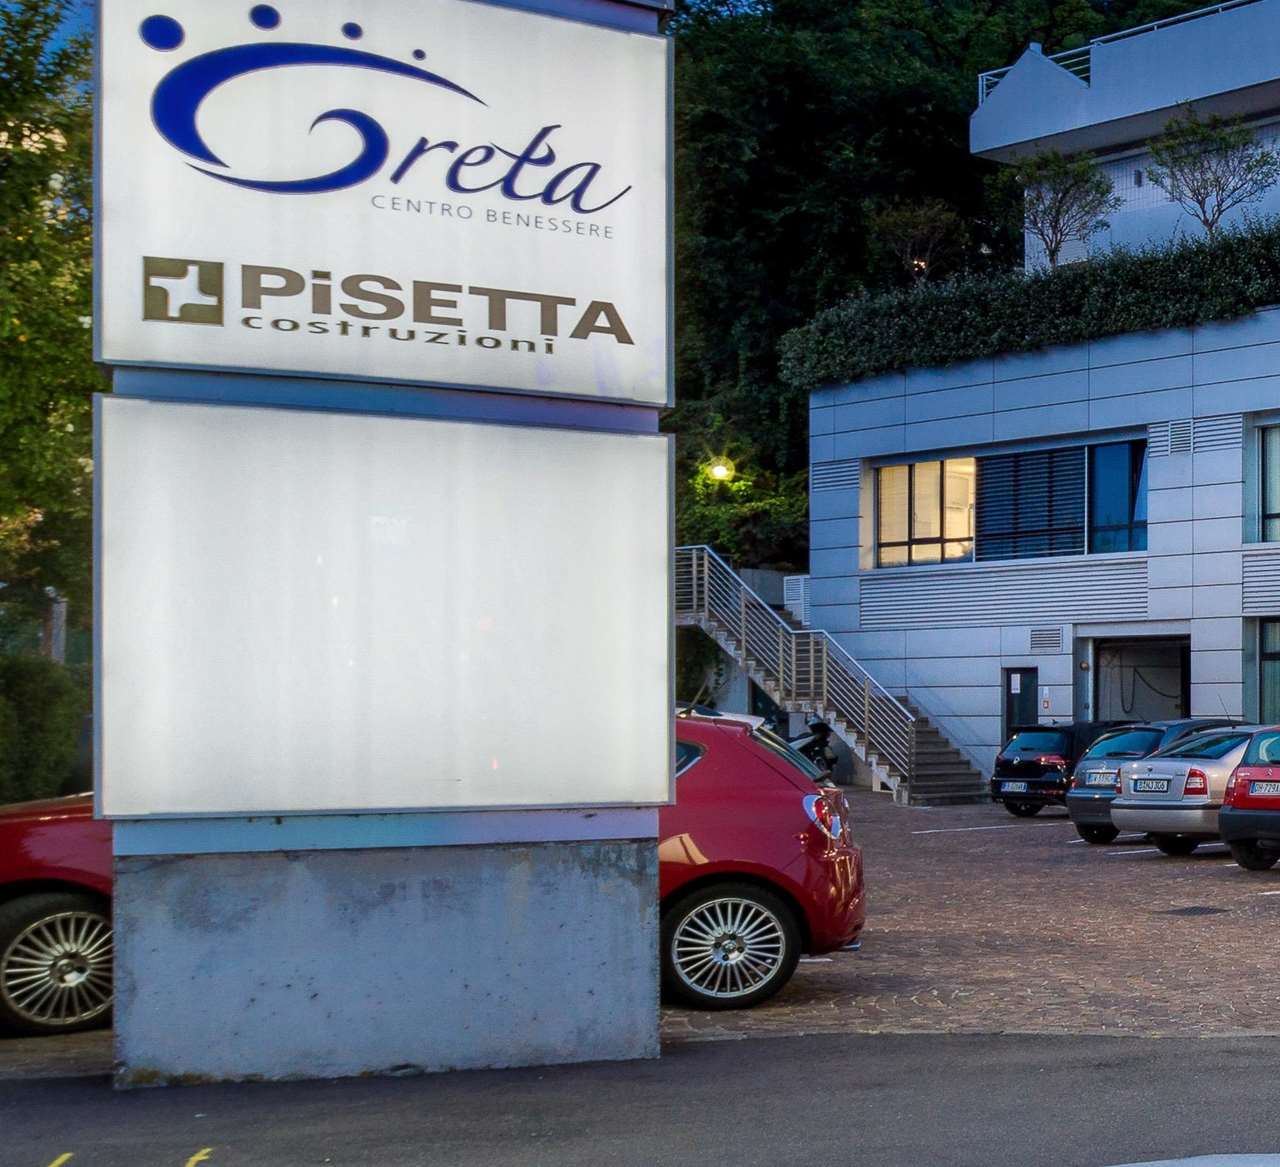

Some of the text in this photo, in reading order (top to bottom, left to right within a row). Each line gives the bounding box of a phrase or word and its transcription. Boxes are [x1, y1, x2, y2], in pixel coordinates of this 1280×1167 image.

[150, 41, 632, 214] Greta
[371, 194, 614, 240] CENTRO BENESSERE
[241, 315, 555, 355] costruzioni
